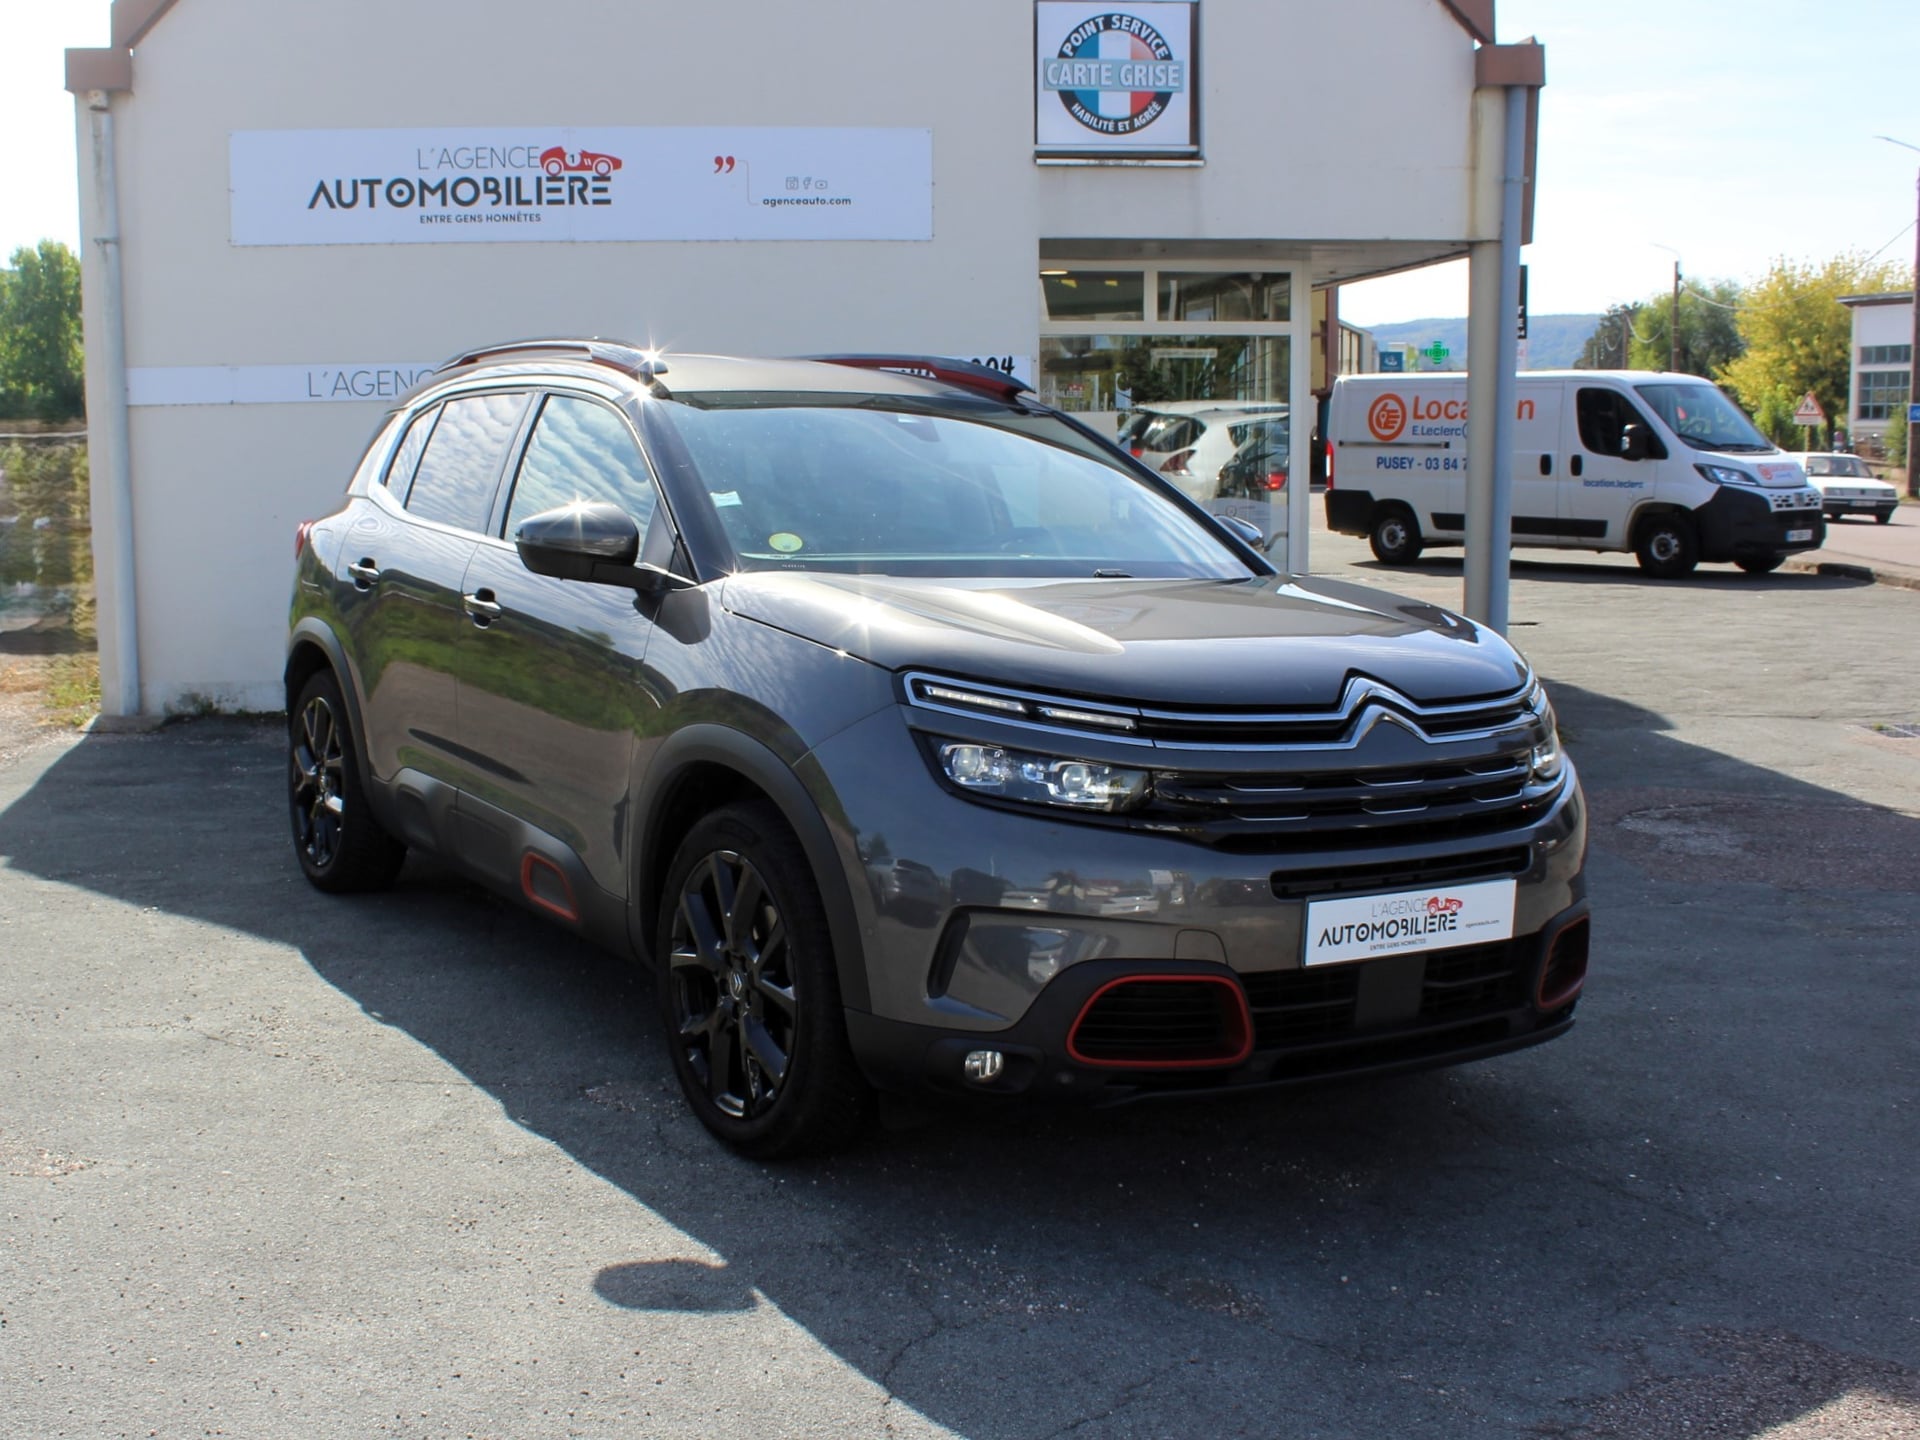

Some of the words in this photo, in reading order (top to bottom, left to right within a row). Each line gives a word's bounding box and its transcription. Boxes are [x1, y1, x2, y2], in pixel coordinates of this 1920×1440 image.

[1062, 17, 1105, 57] POINT
[1111, 15, 1168, 59] SERVICE
[1047, 63, 1112, 86] CARTE
[1120, 64, 1180, 87] GRISE
[1071, 102, 1115, 132] HABILITÉ
[1118, 121, 1130, 132] ET
[417, 146, 541, 170] L'AGENCE
[762, 197, 852, 208] agenceauto.com
[420, 214, 453, 224] ENTRE
[455, 213, 483, 224] GENS
[485, 211, 542, 223] HONNÊTES
[971, 355, 1015, 376] 04
[1377, 456, 1415, 470] PUSEY
[1425, 457, 1440, 471] 03
[1443, 457, 1458, 471] 84
[1371, 897, 1428, 918] L'AGENCE
